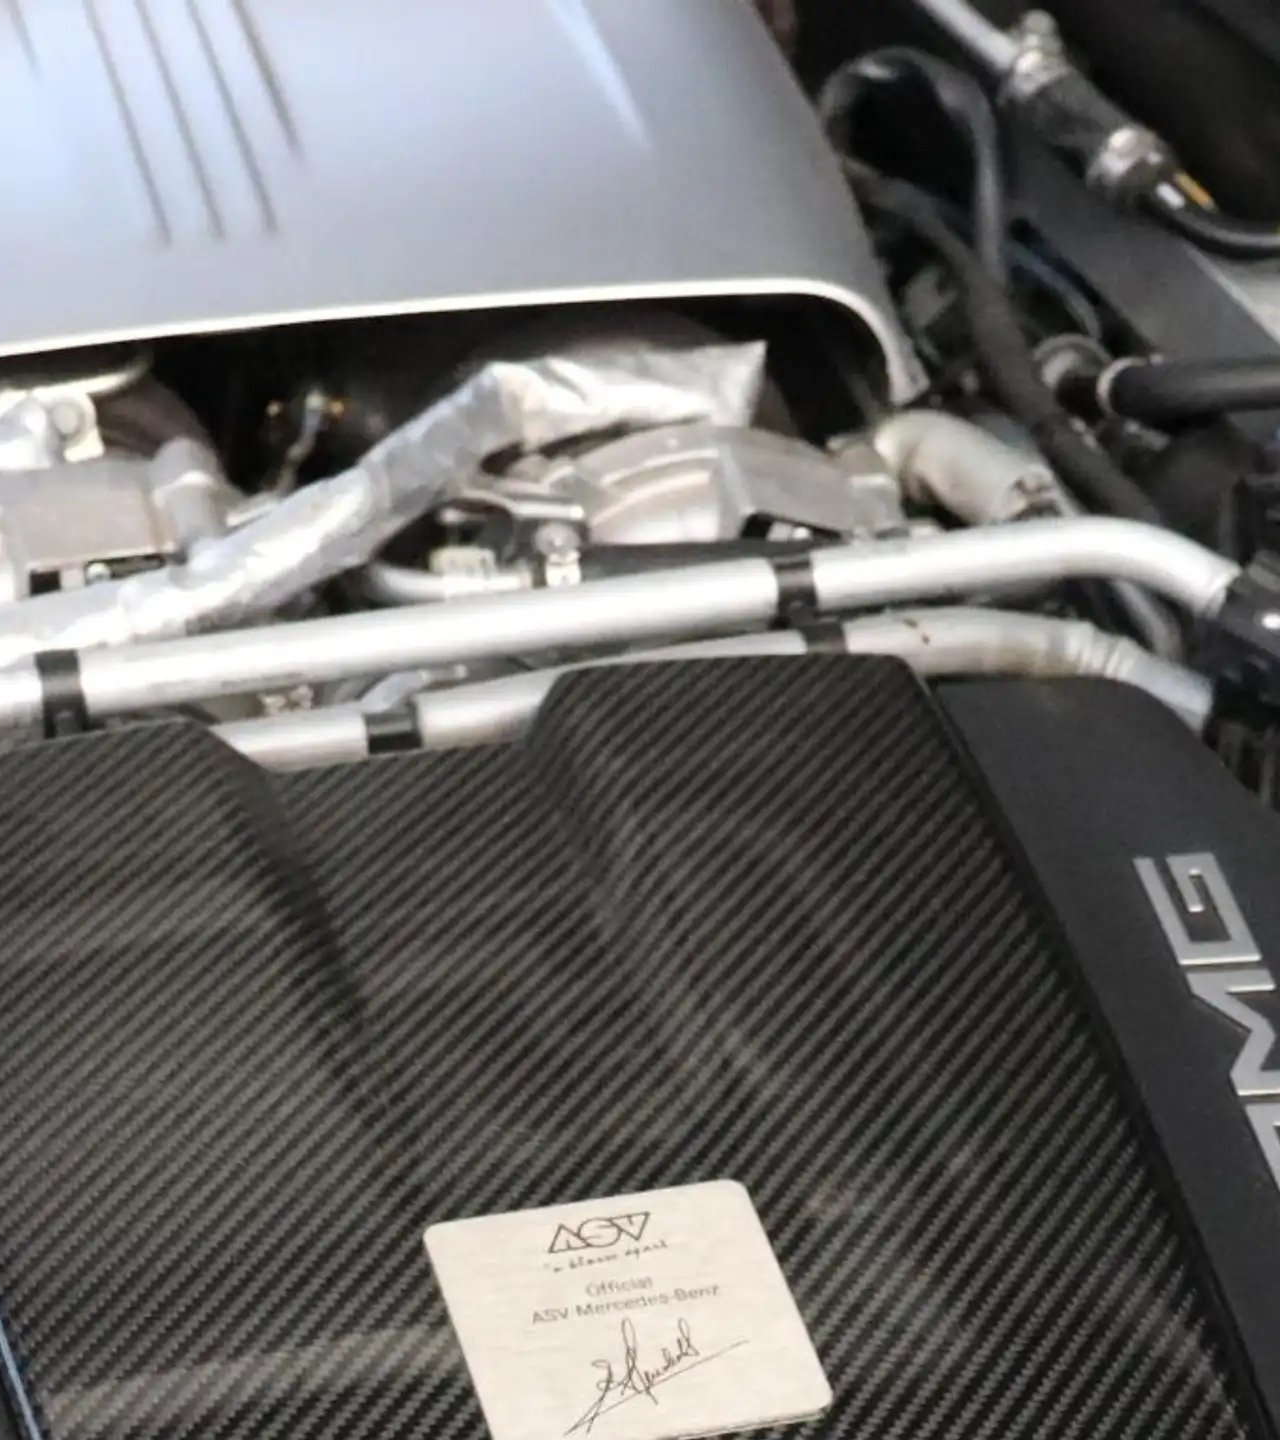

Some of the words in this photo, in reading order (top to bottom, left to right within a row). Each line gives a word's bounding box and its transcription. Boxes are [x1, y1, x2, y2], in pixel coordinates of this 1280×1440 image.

[547, 1211, 651, 1254] ASV
[584, 1275, 654, 1297] Official
[532, 1306, 569, 1325] ASV
